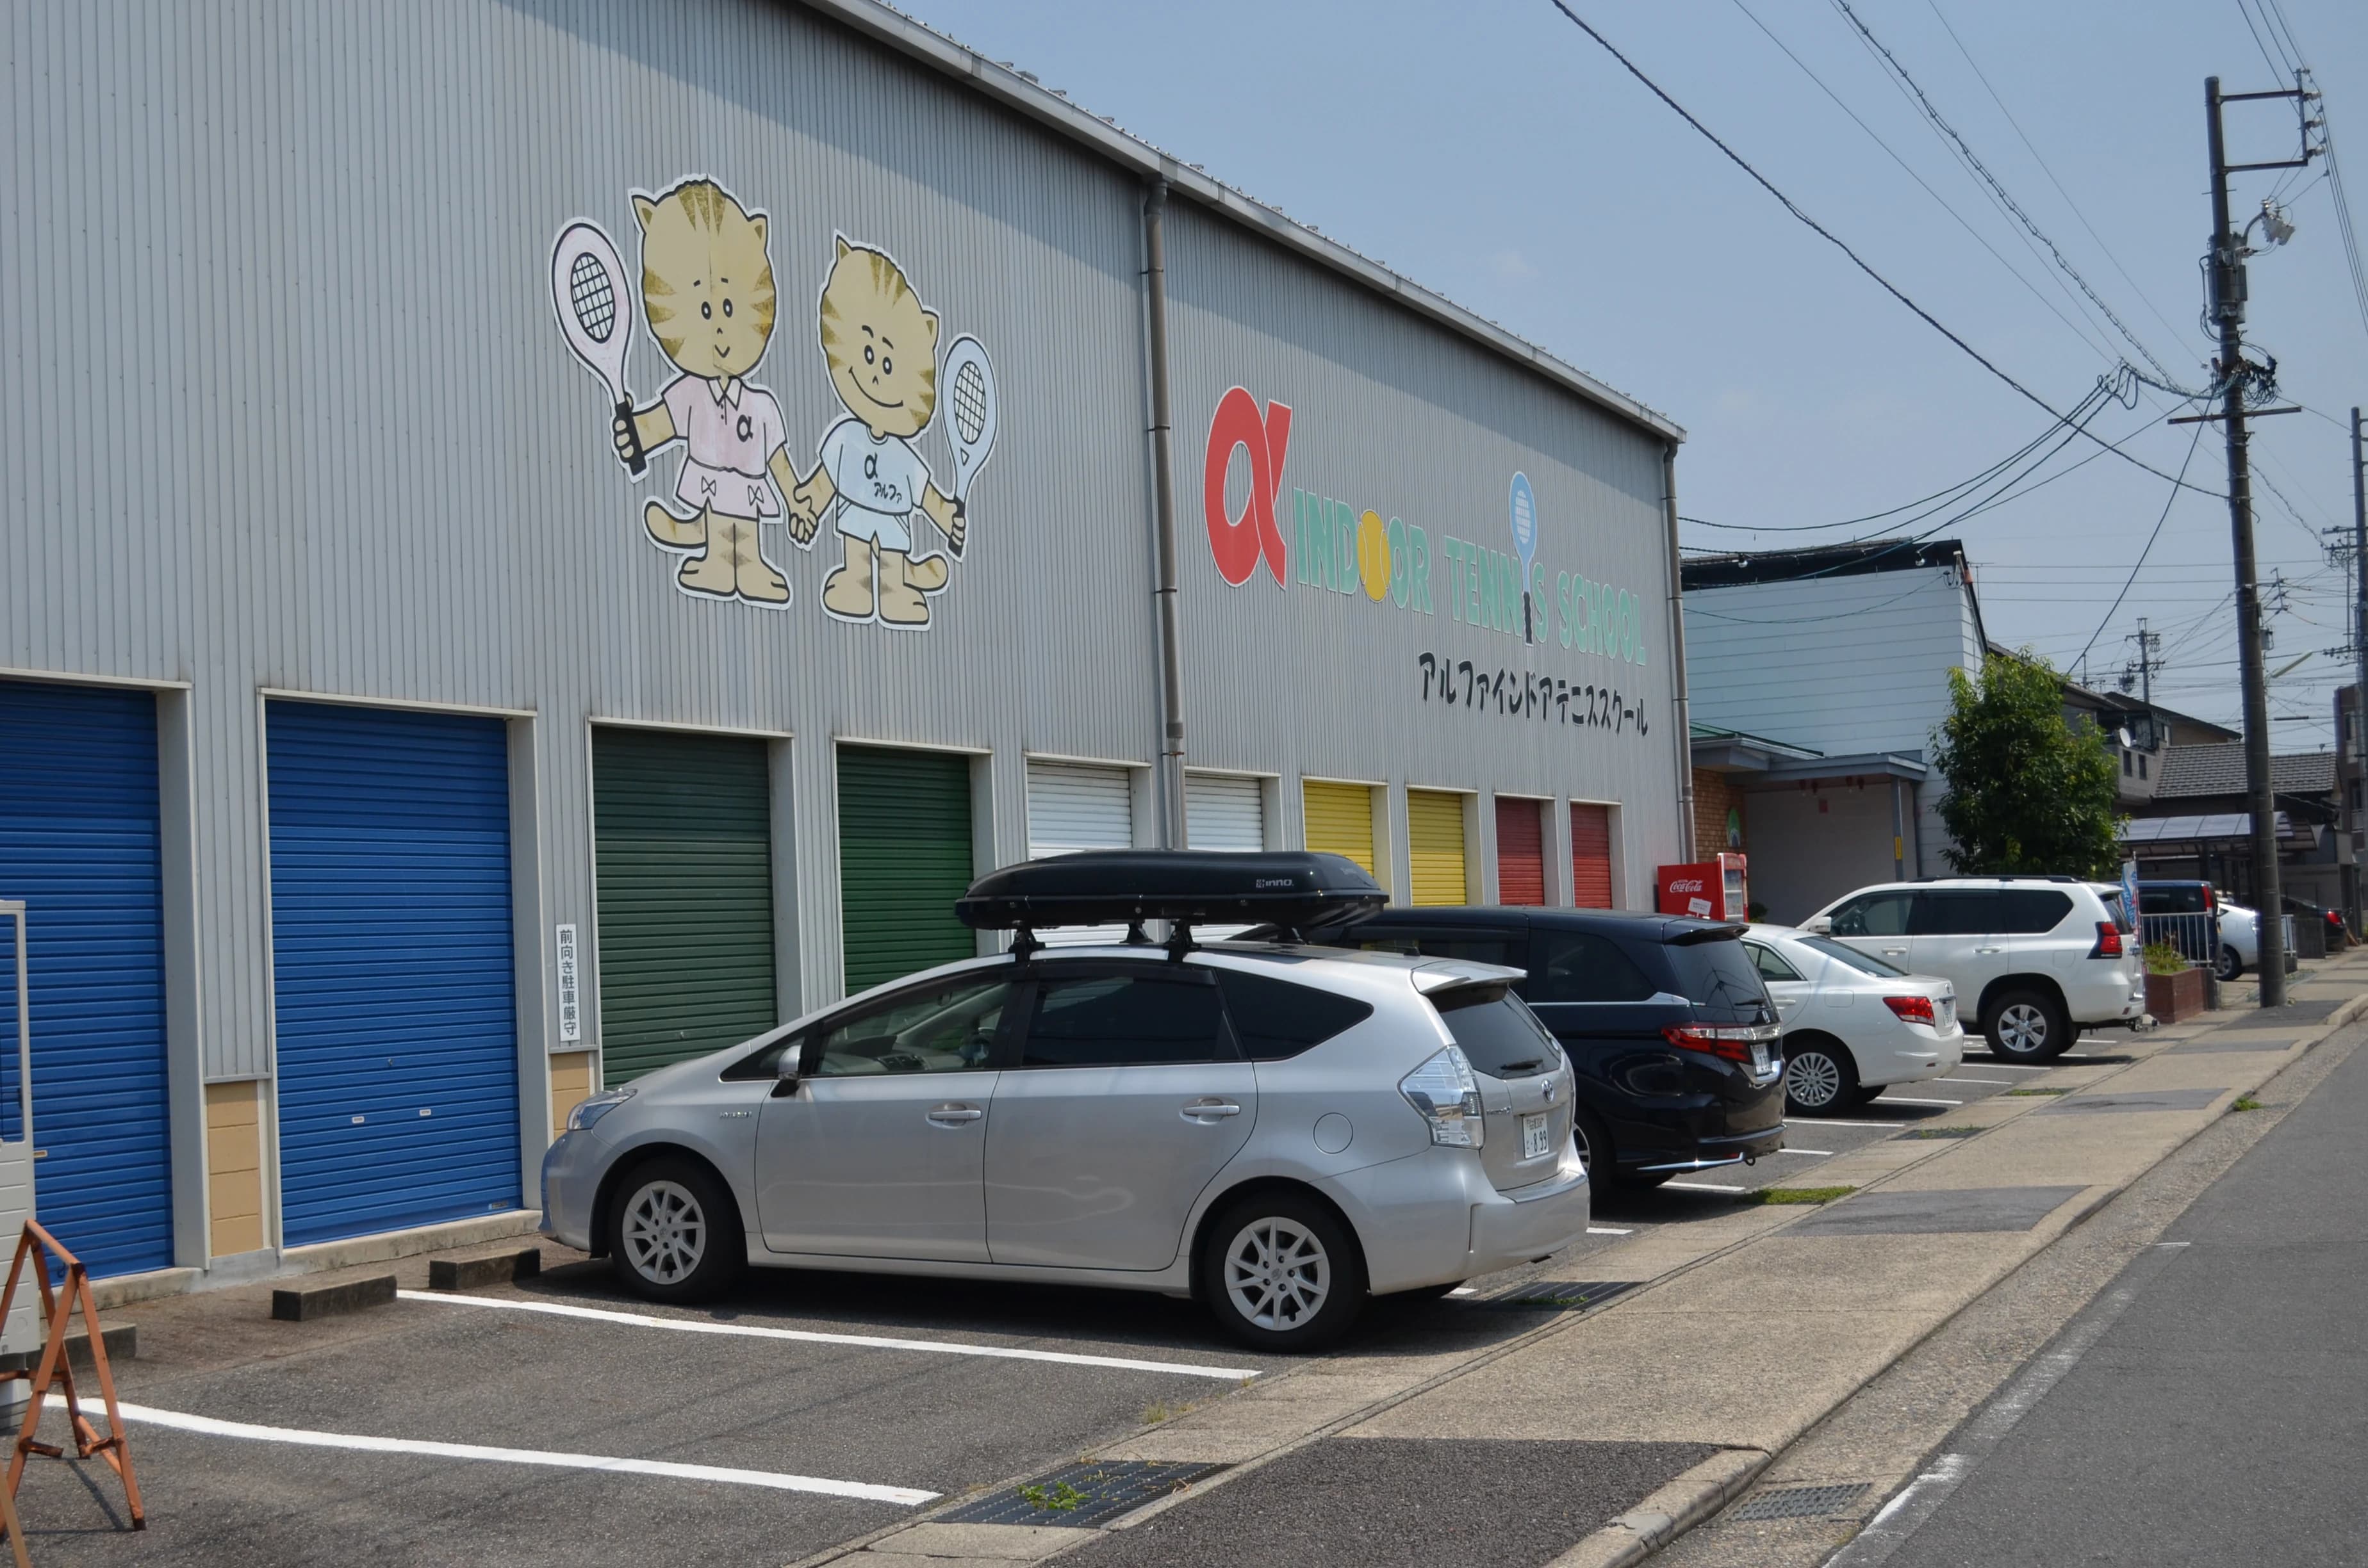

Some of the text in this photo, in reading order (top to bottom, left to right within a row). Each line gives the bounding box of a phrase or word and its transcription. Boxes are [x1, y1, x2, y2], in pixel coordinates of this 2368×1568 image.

[1294, 471, 1647, 666] INDOOR TENNIS SCHOOL
[1418, 651, 1649, 737] アルファインドアテニススクール
[559, 929, 577, 1036] 前向き駐車厳守
